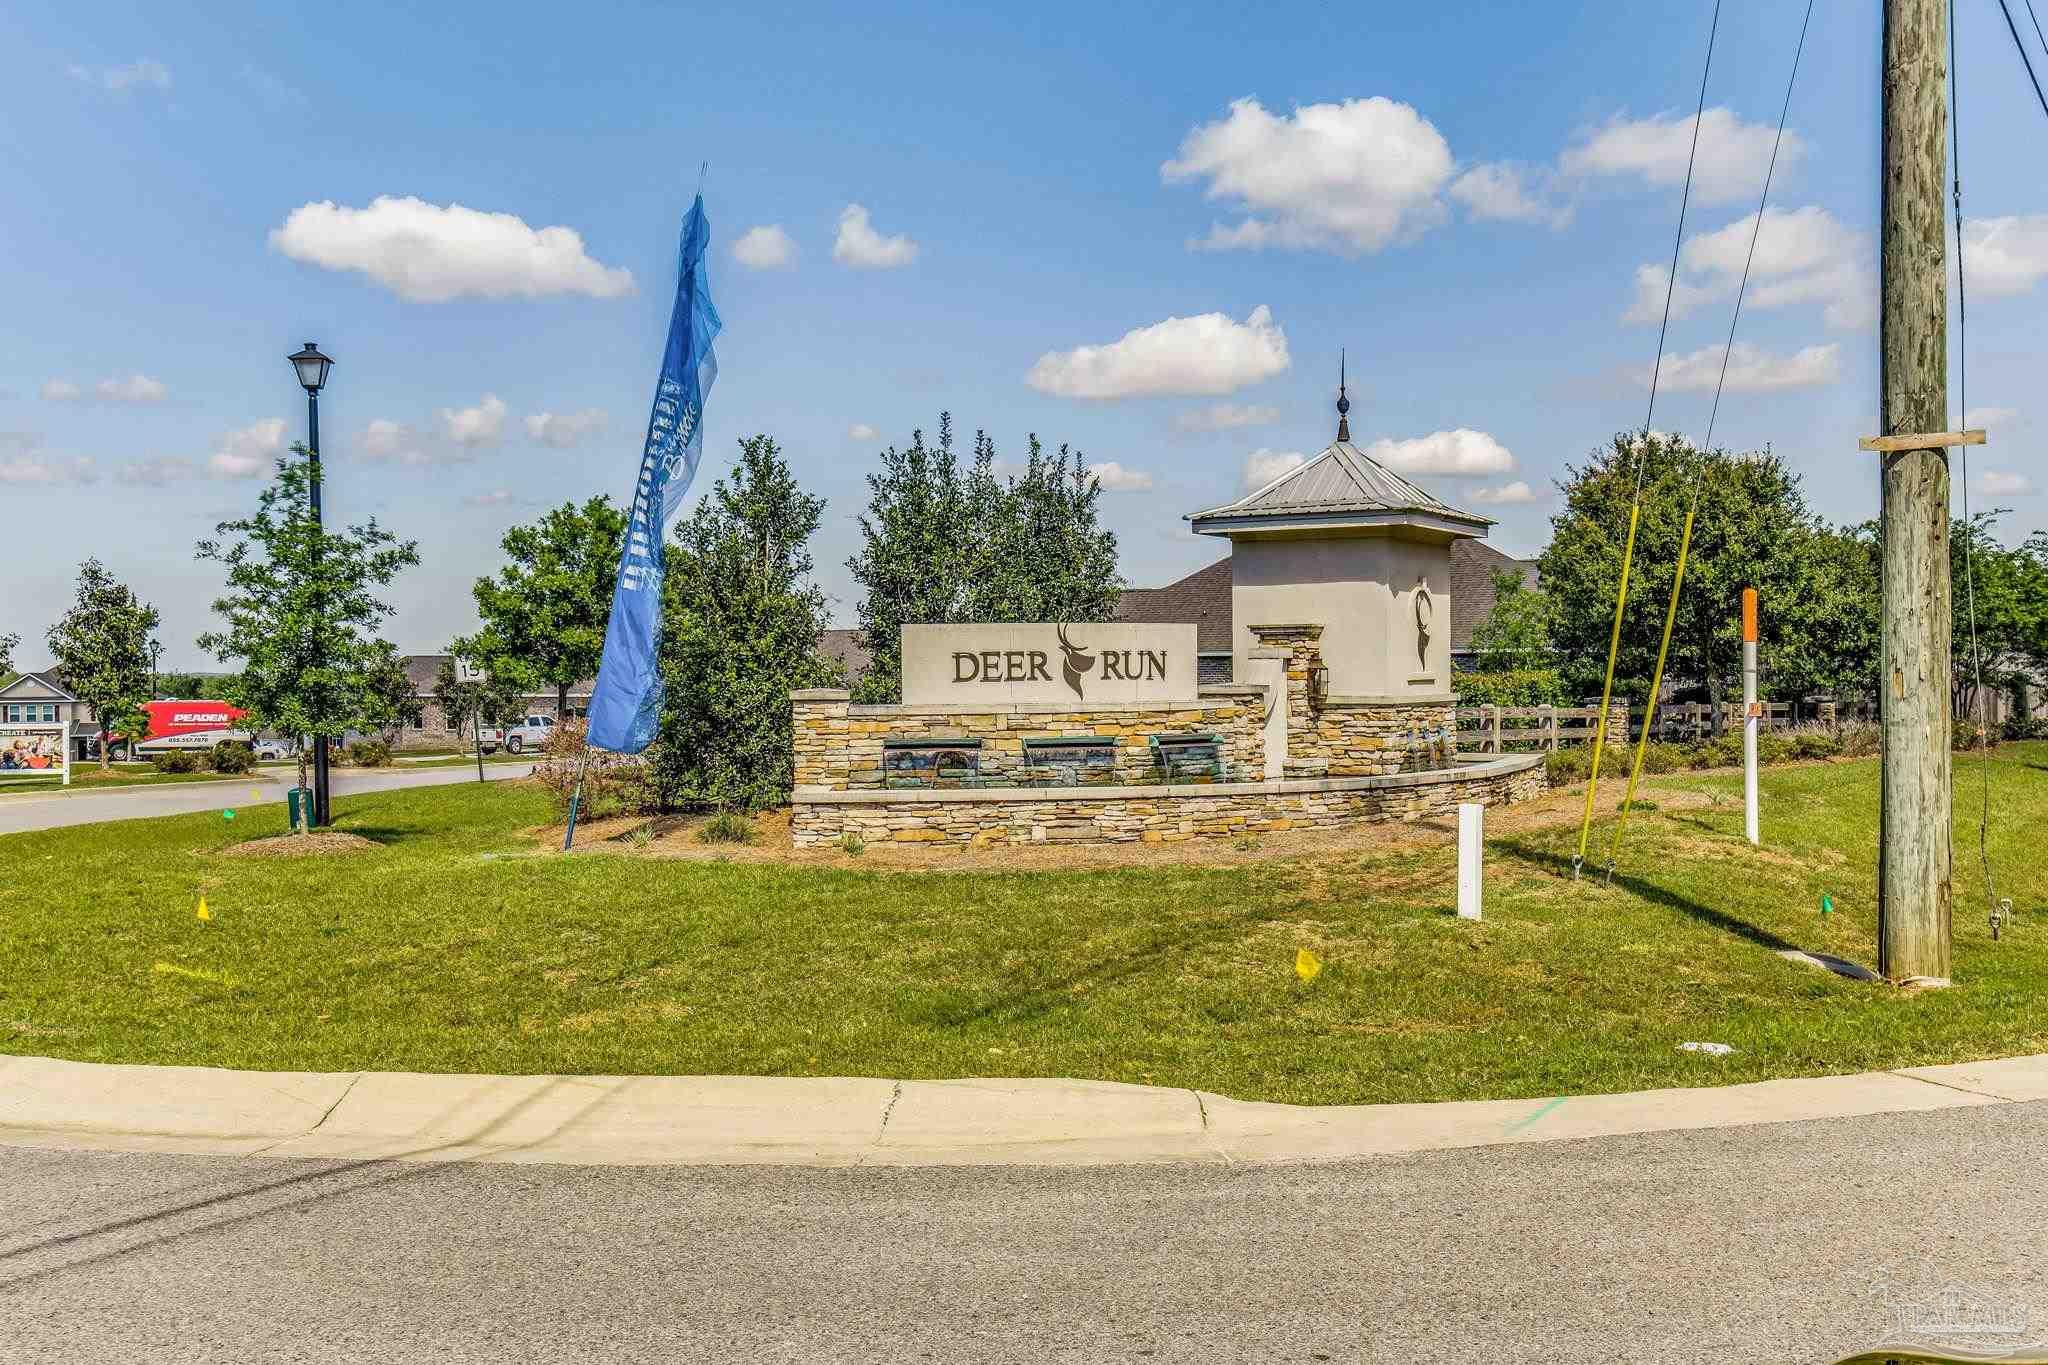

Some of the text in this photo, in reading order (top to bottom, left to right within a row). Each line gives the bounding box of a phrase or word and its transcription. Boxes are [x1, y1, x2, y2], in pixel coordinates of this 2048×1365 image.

[951, 650, 1168, 683] DEER RUN
[174, 713, 229, 722] PEADEN
